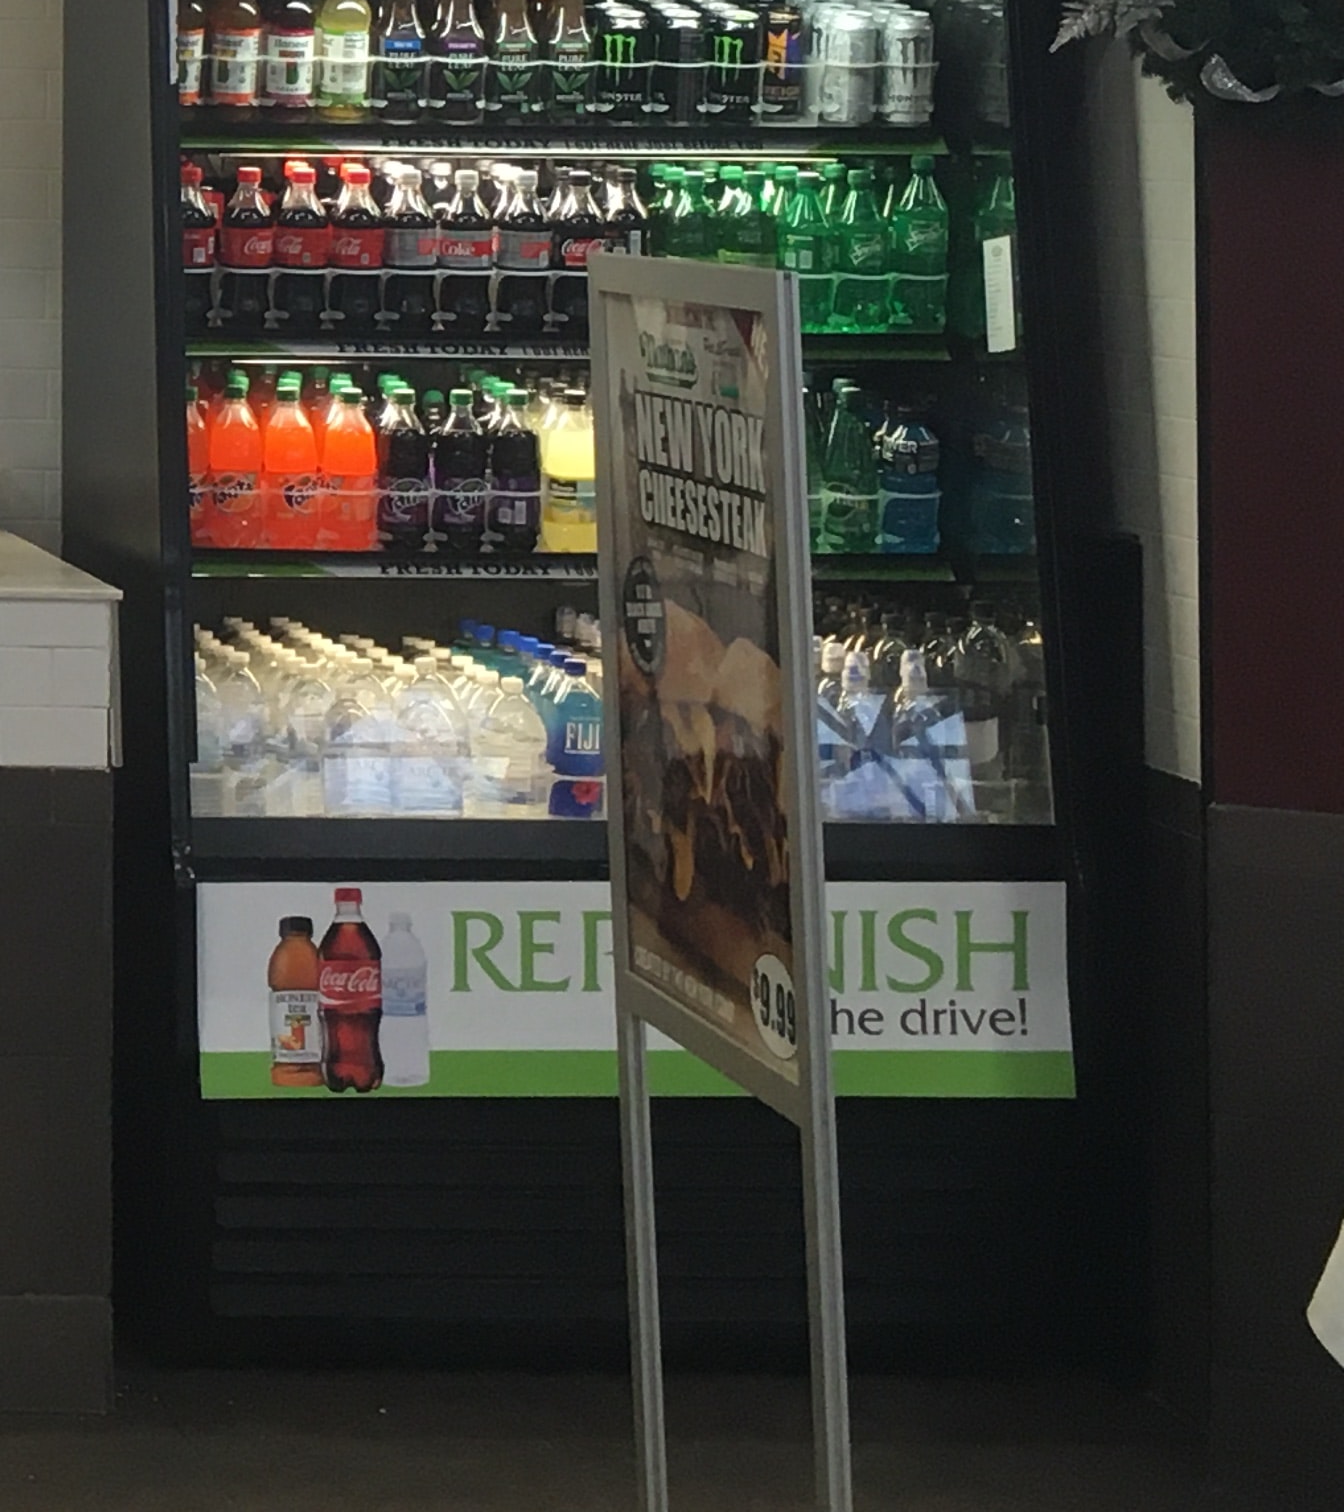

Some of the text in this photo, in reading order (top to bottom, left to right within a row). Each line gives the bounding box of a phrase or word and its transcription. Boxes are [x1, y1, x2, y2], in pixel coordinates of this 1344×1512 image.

[634, 391, 766, 494] NEW YORK
[638, 468, 769, 558] CHEESESTEAK
[564, 723, 602, 749] FIJI
[900, 998, 1029, 1038] drive!
